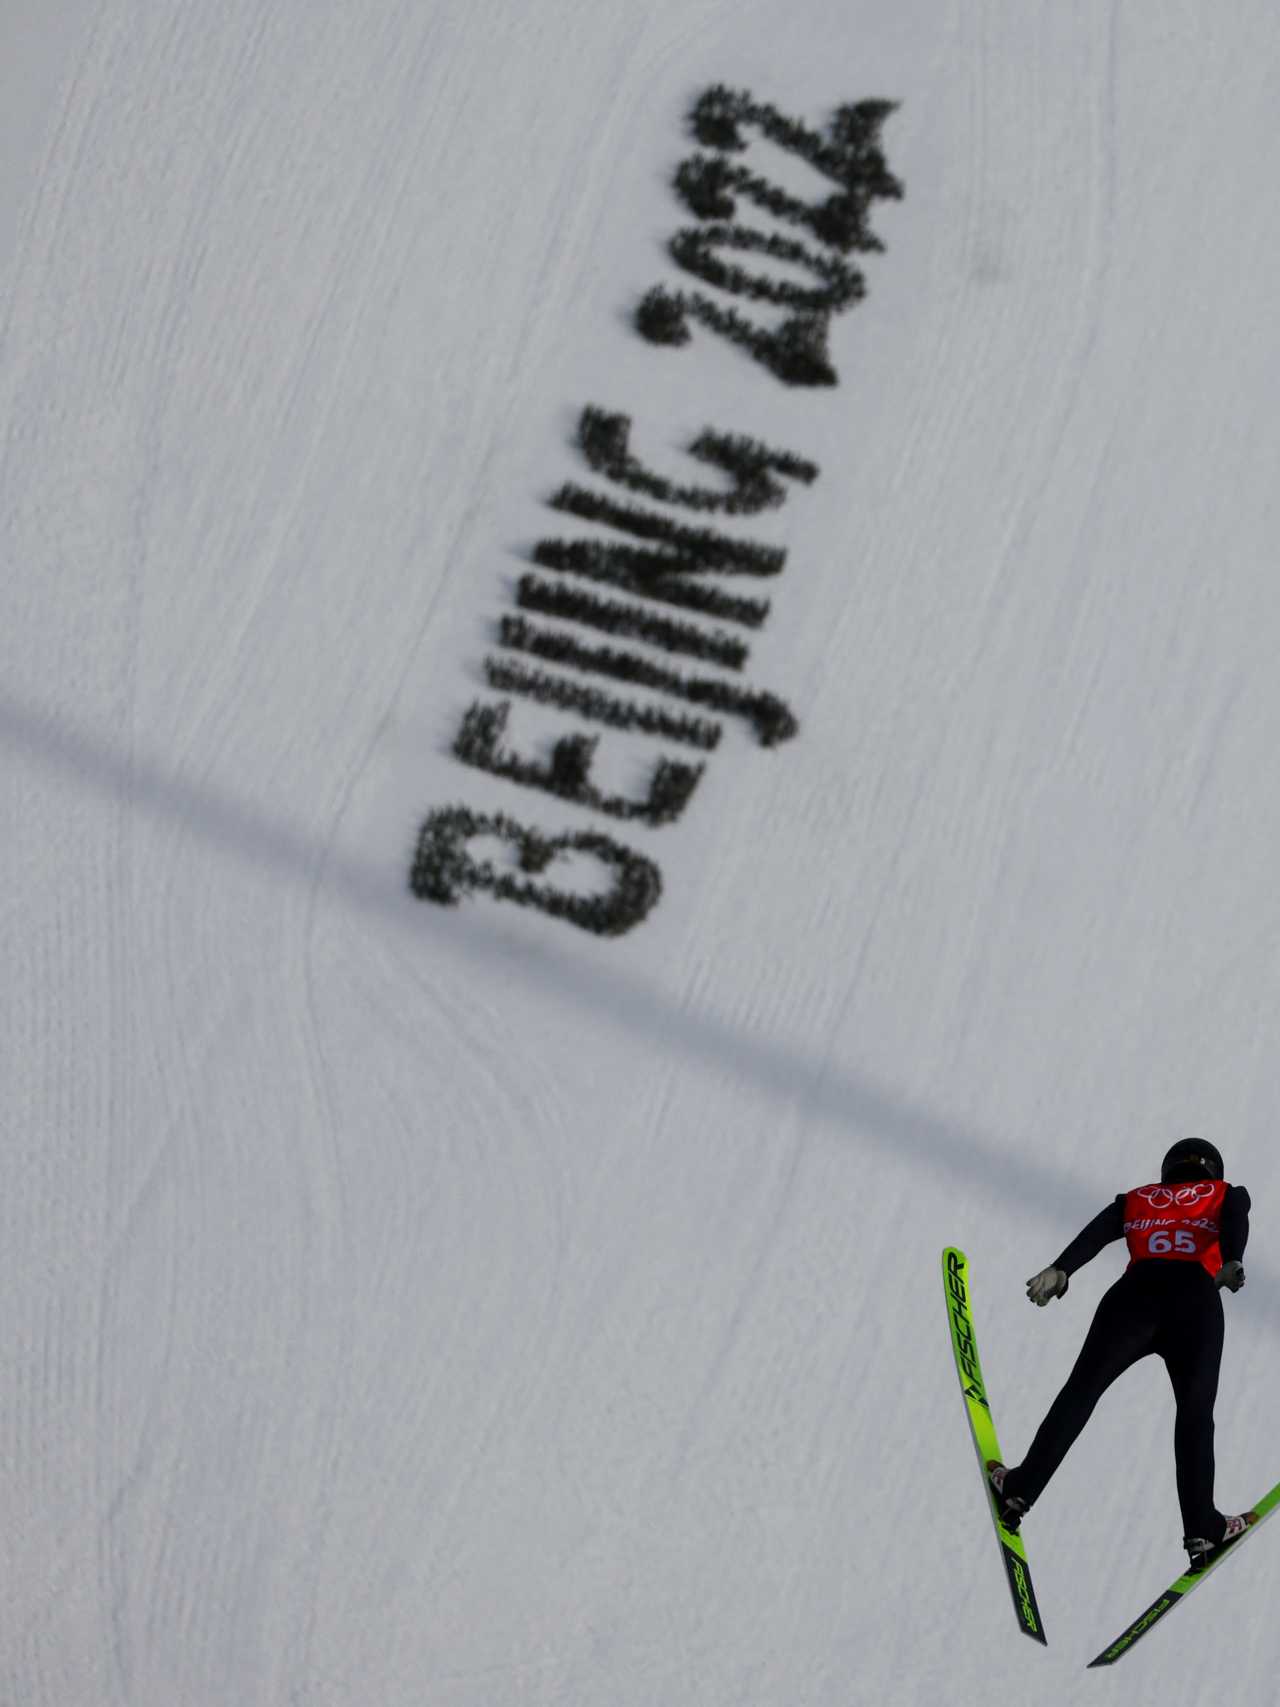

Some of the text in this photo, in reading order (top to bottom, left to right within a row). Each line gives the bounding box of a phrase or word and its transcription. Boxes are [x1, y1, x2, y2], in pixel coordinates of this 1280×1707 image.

[408, 82, 904, 938] BEIJING 2022
[1148, 1230, 1196, 1254] 65
[947, 1252, 981, 1388] FISCHER
